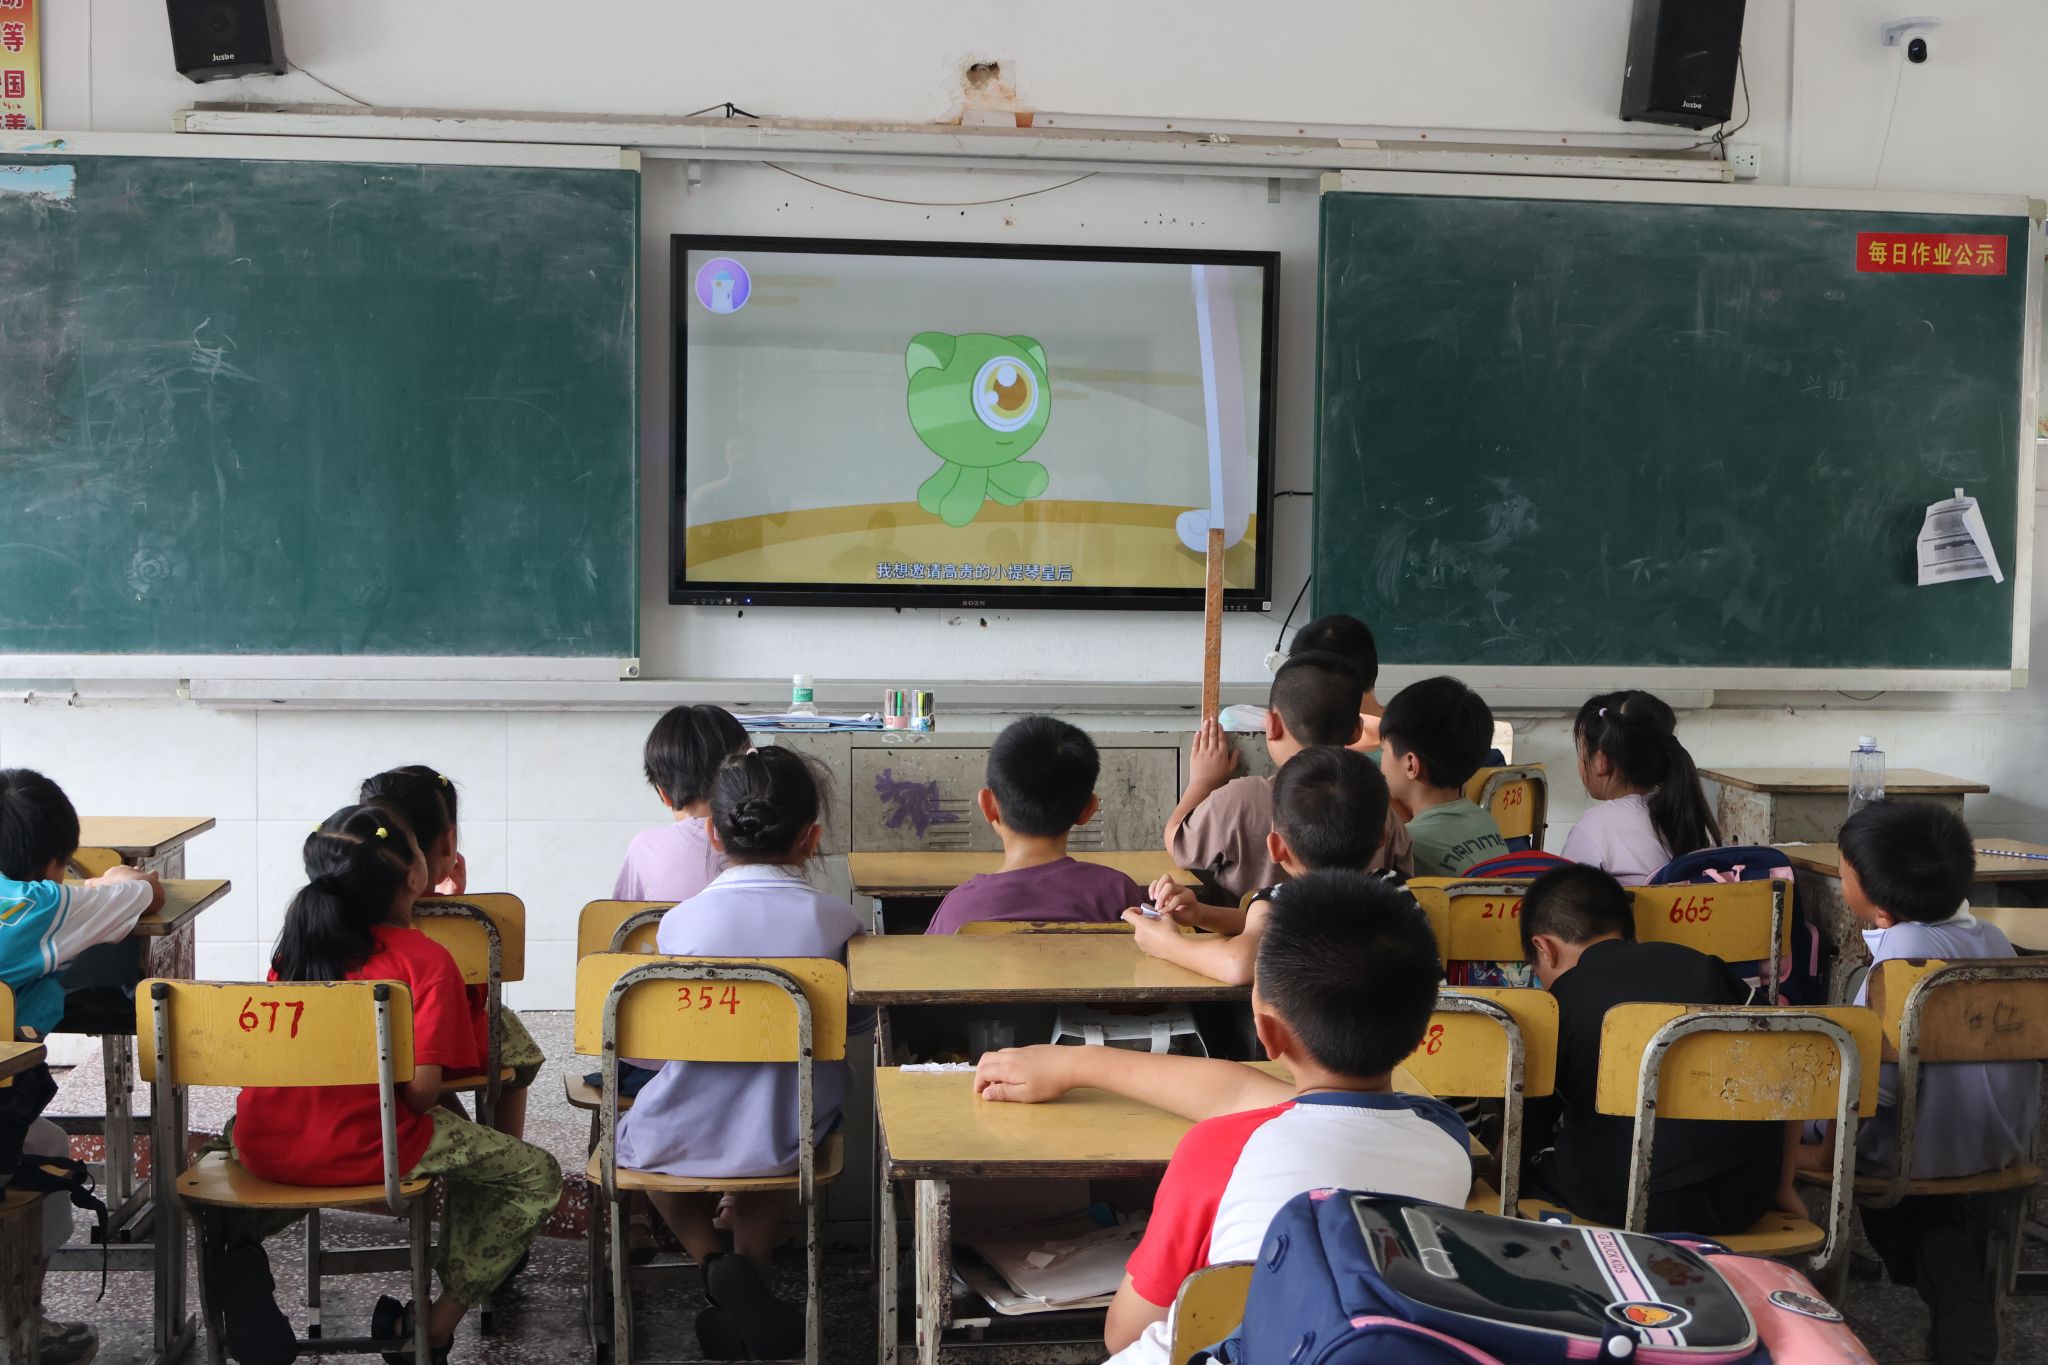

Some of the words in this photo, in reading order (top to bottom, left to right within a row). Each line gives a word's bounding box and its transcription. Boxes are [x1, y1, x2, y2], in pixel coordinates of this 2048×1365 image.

[1868, 240, 1995, 267] 每日作业公示
[875, 561, 1073, 582] 我想邀请高贵的小提琴皇后
[1503, 786, 1523, 811] 528
[1669, 896, 1714, 924] 665
[677, 985, 741, 1015] 354
[238, 996, 304, 1039] 677
